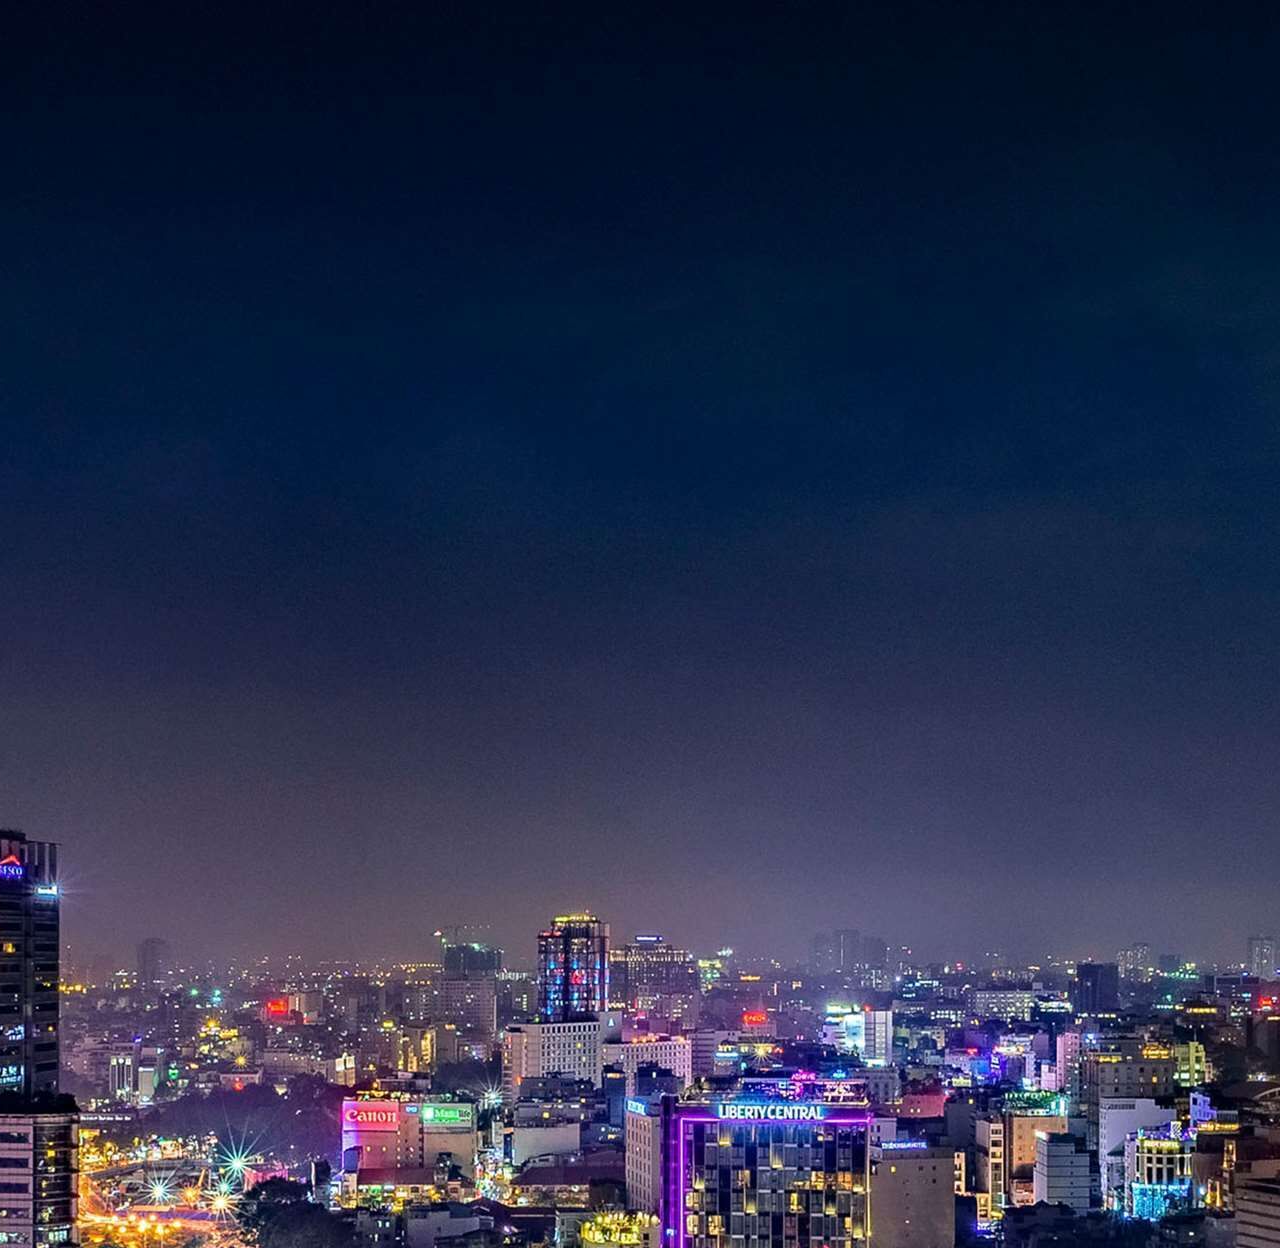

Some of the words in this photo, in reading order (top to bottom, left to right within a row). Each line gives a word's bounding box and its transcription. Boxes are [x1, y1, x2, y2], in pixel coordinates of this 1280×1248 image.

[345, 1109, 397, 1122] Canon
[719, 1104, 767, 1119] LIBERTY
[768, 1105, 824, 1120] CENTRAL
